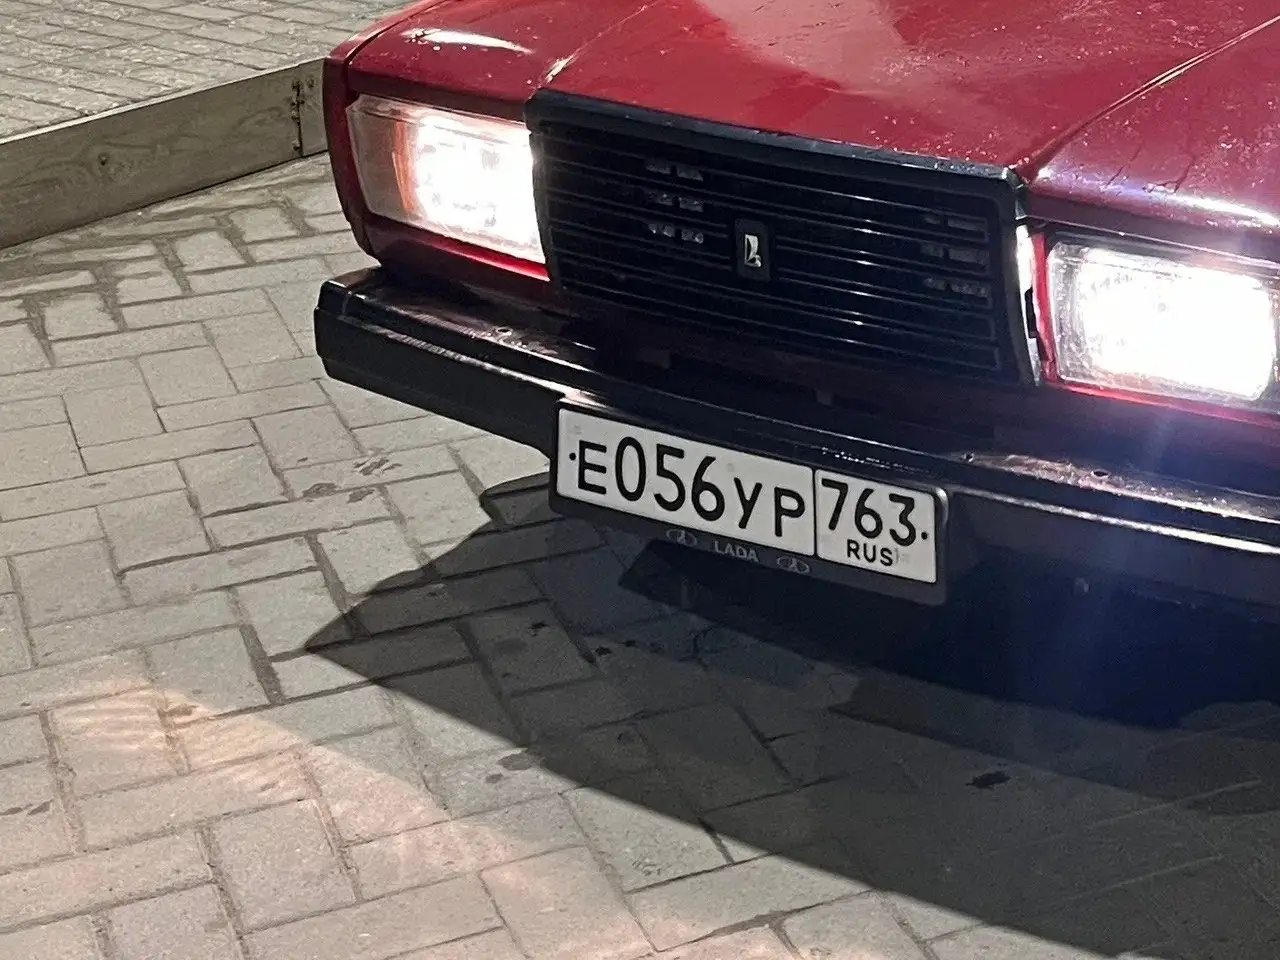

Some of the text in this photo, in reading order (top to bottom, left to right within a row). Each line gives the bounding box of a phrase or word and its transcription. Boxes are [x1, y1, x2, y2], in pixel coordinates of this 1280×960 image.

[821, 477, 917, 547] 763
[714, 541, 760, 563] LADA
[846, 539, 894, 567] RUS
